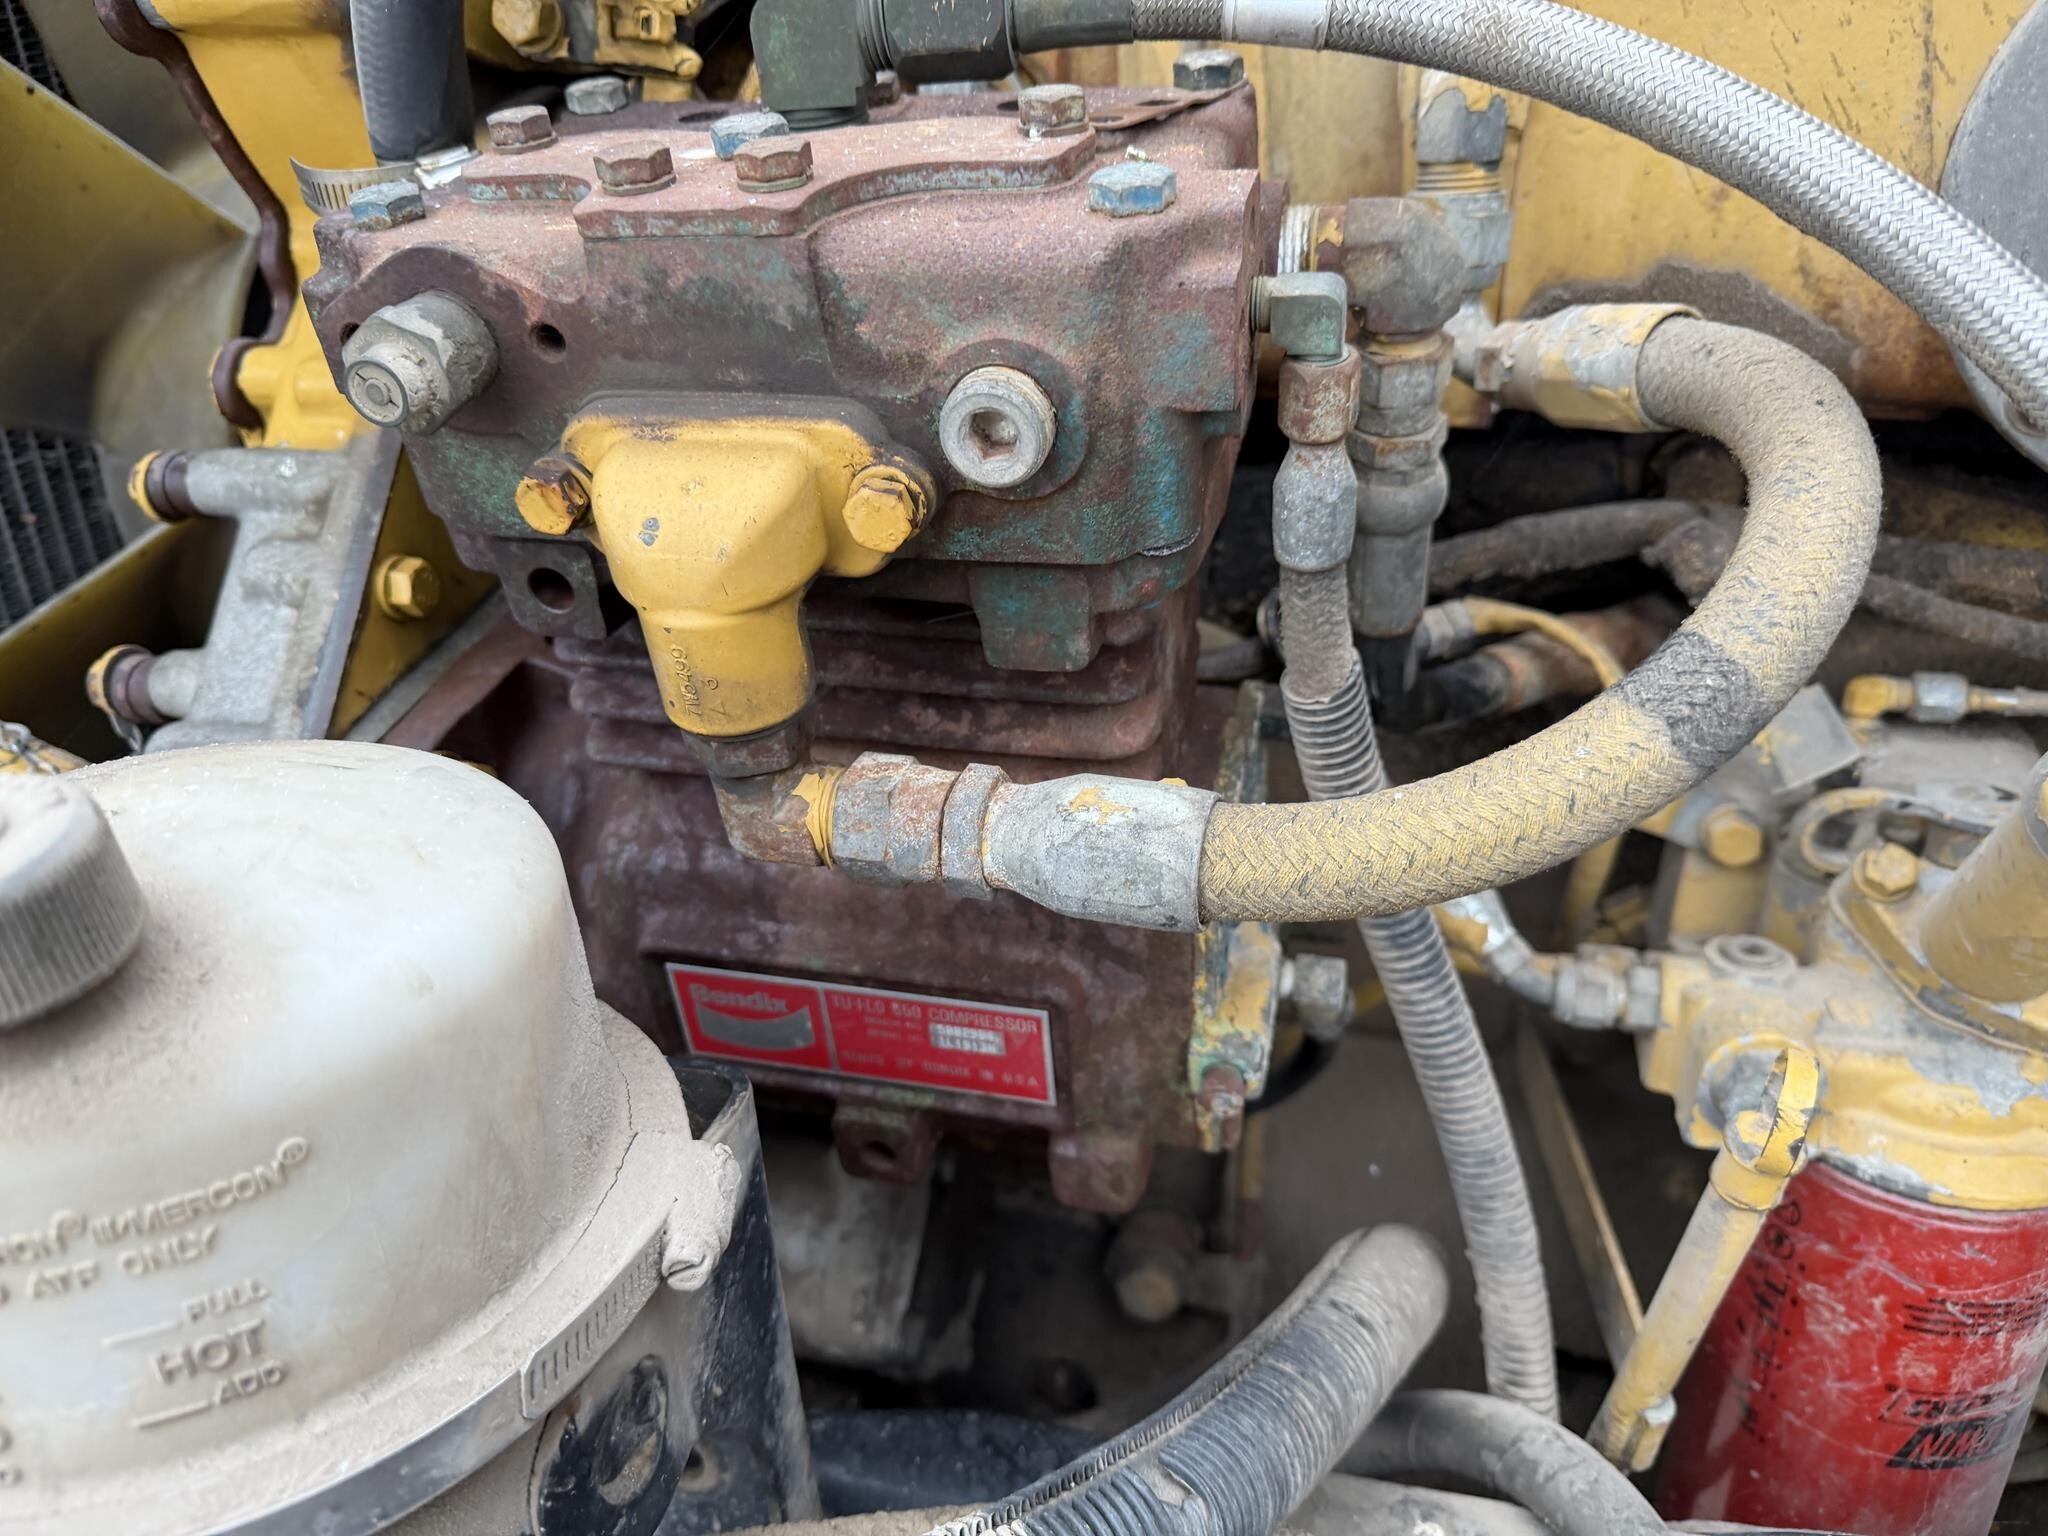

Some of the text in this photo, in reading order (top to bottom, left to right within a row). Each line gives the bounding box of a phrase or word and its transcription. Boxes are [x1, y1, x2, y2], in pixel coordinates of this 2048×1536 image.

[689, 983, 788, 1013] Bendix
[928, 1007, 1038, 1033] COMPRESSOR
[118, 1223, 219, 1278] ONLY
[152, 1319, 265, 1385] HOT
[213, 1359, 290, 1406] ADD
